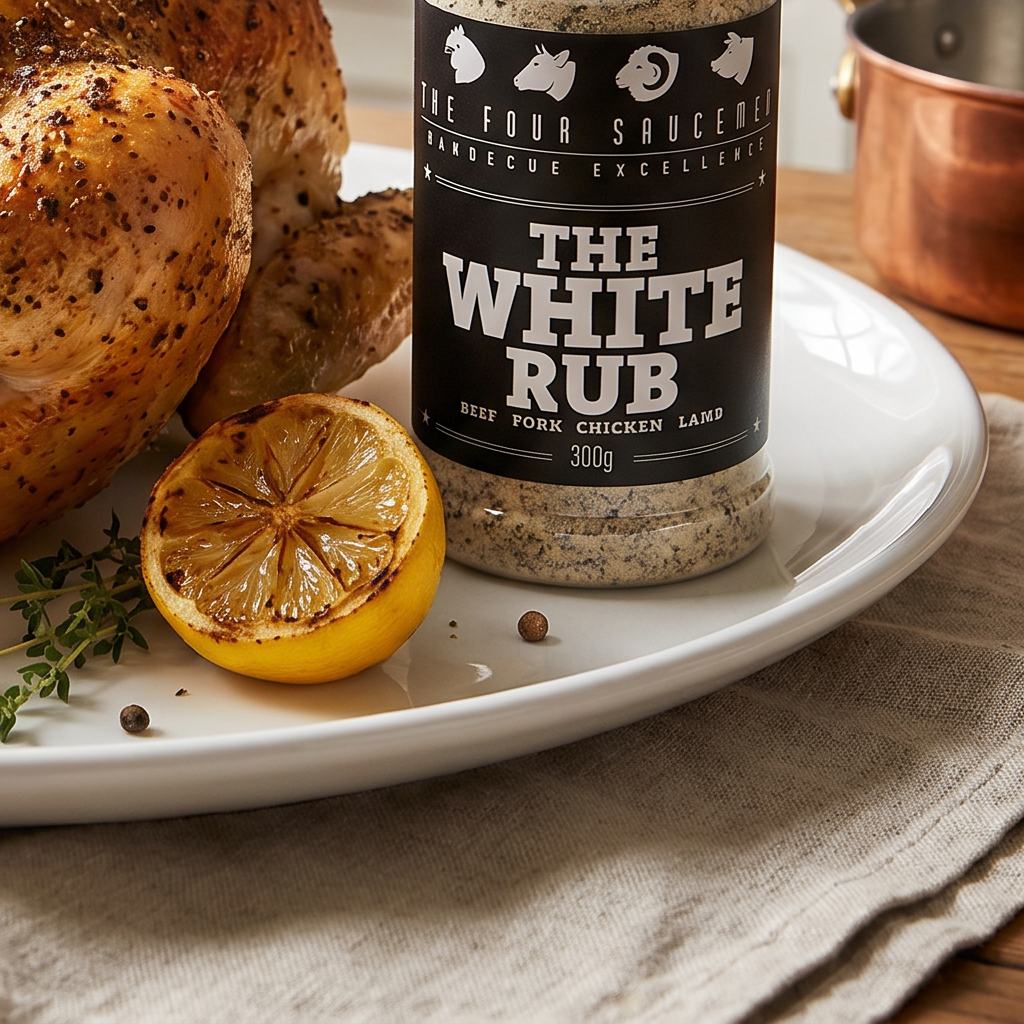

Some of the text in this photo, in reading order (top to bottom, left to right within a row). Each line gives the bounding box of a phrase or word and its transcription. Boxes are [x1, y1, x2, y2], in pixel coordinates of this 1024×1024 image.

[421, 80, 455, 124] THE
[483, 105, 570, 144] FOUR
[529, 222, 658, 272] THE
[442, 251, 743, 349] WHITE
[506, 346, 678, 416] RUB
[460, 401, 498, 423] BEEF
[576, 419, 663, 434] CHICKEN
[570, 444, 613, 473] 300g
